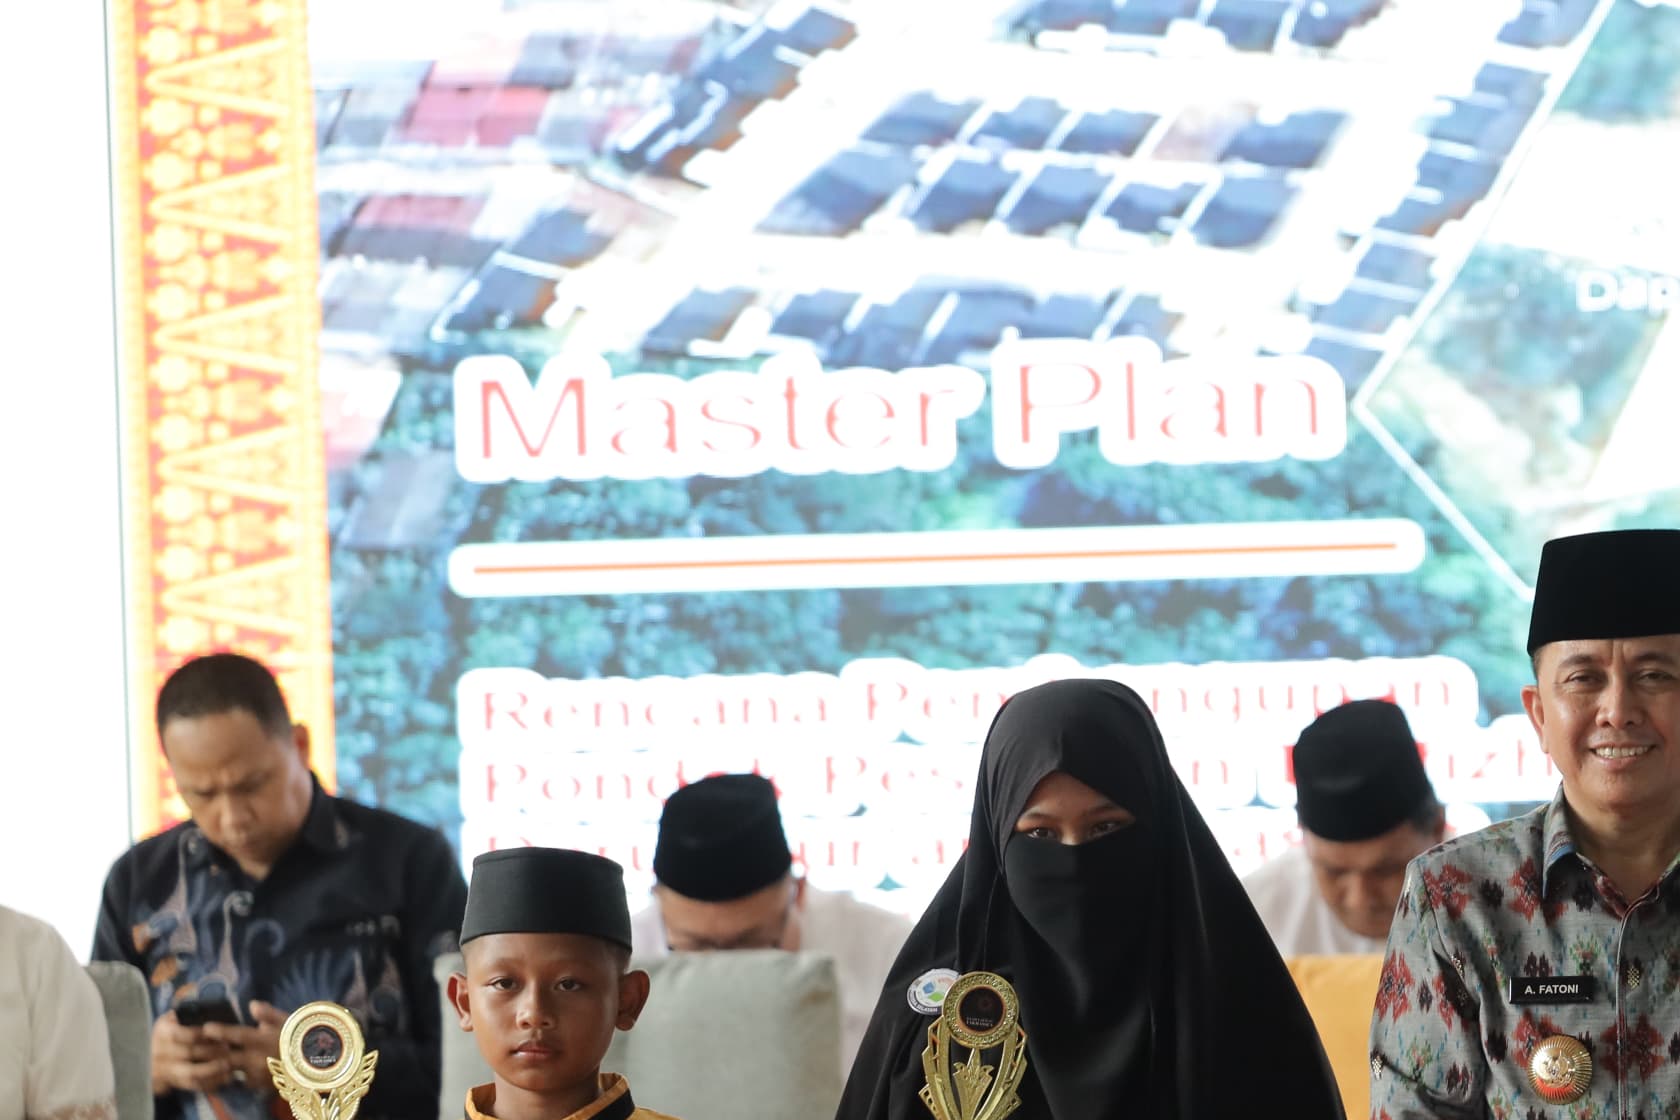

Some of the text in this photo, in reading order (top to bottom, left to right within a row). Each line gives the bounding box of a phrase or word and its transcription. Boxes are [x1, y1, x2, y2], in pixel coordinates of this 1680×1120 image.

[480, 361, 1319, 461] Master Plan
[483, 691, 829, 732] Rencana
[1524, 984, 1579, 994] A. FATONI
